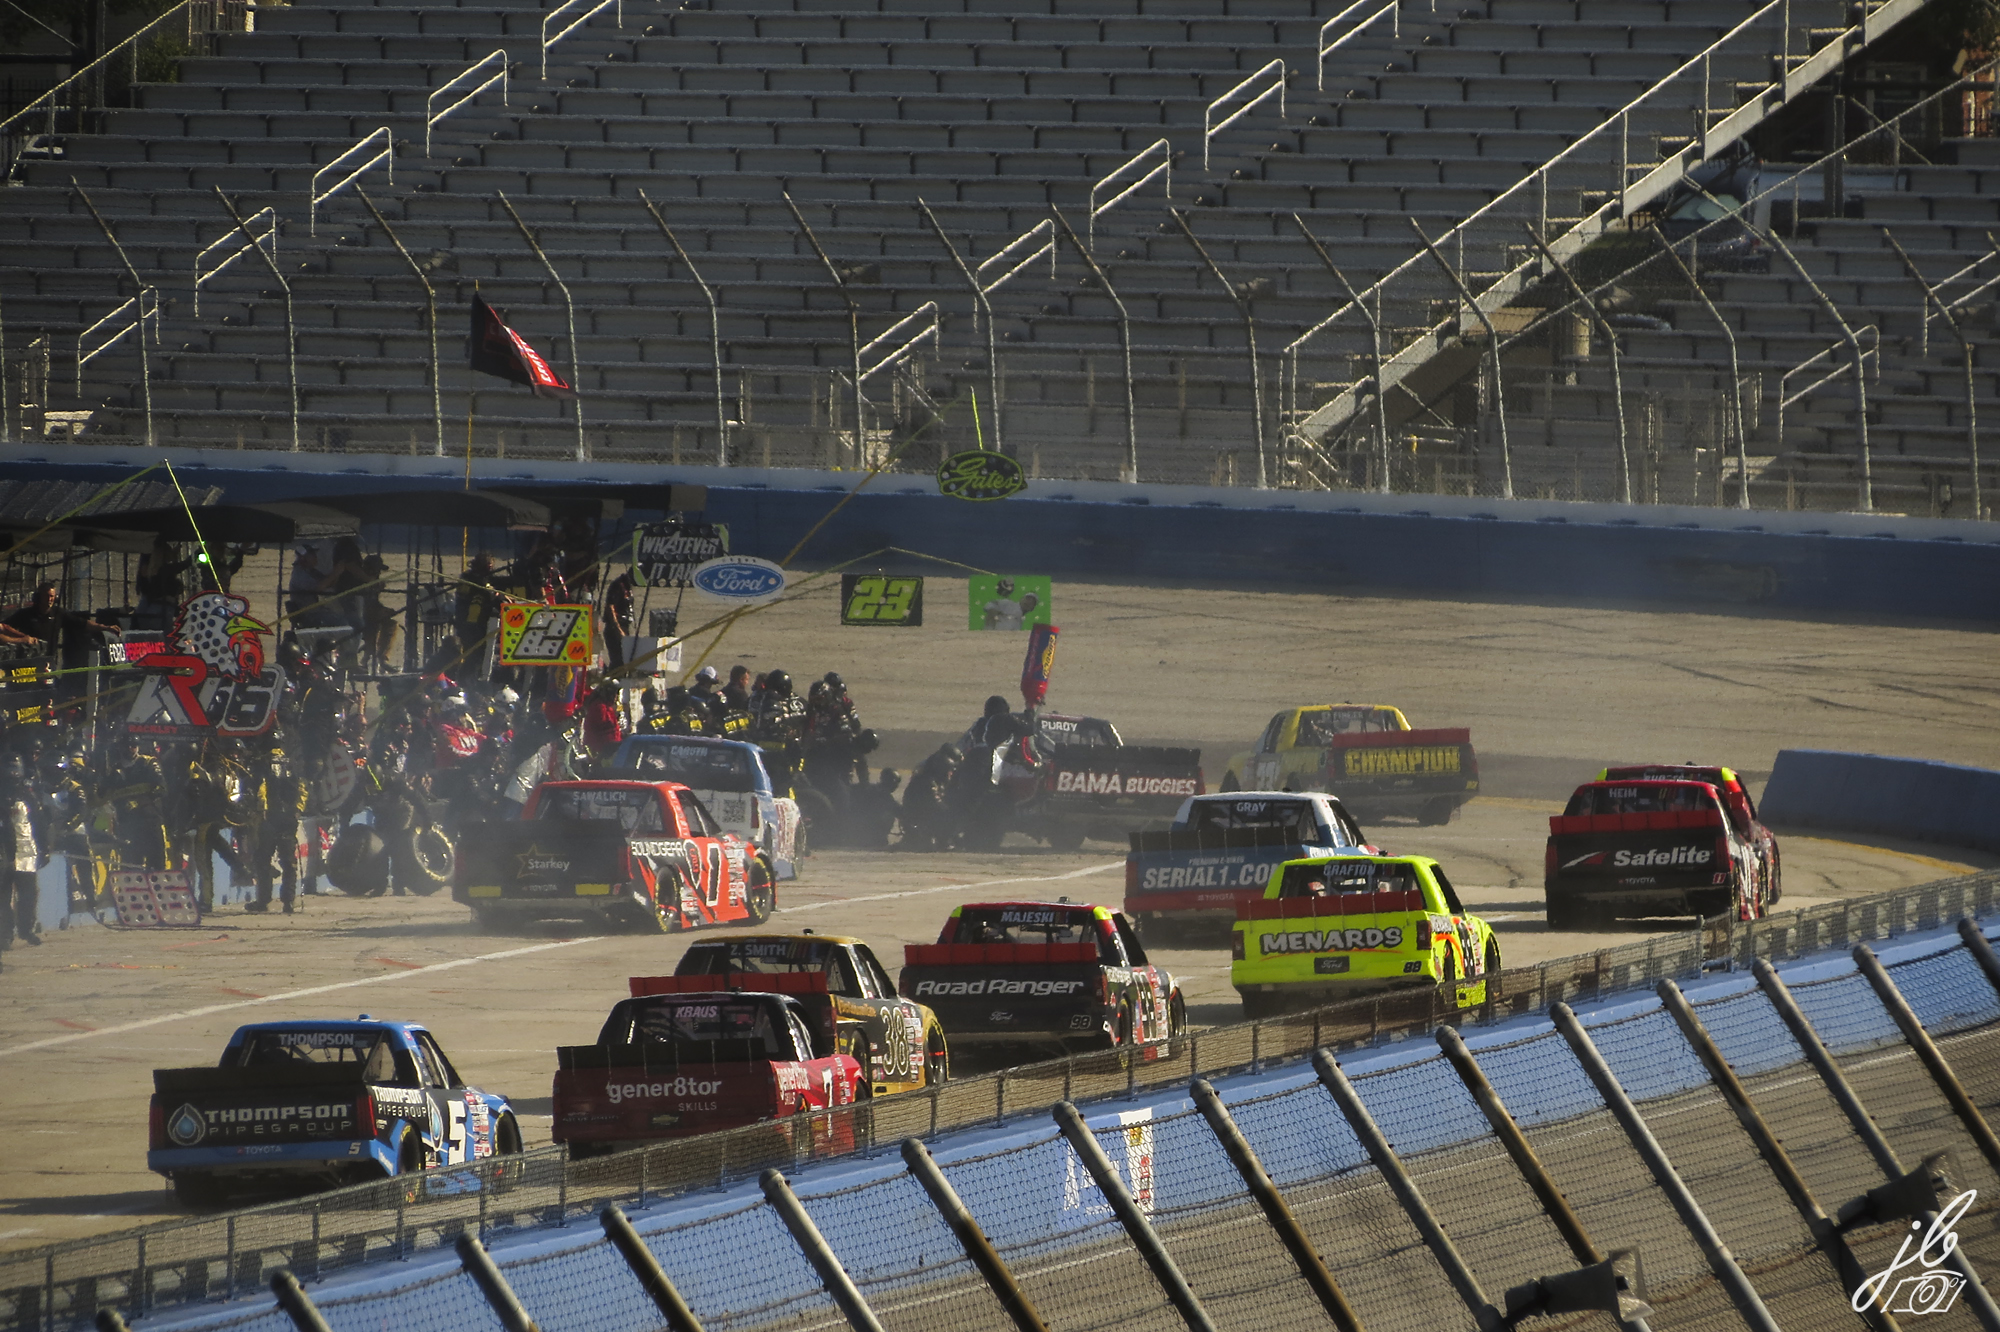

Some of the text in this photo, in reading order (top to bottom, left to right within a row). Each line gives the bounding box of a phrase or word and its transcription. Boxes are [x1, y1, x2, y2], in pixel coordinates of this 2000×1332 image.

[940, 457, 1019, 495] Gates
[642, 531, 720, 555] WHATEVER
[650, 563, 698, 579] IT TAK
[713, 568, 765, 591] Ford
[847, 580, 918, 620] 23
[512, 609, 580, 660] 2
[1041, 720, 1078, 732] PURDY
[1345, 747, 1461, 775] CHAMPION
[1057, 771, 1197, 796] BAMA BUGGIES
[573, 790, 628, 801] SAWALICH
[1609, 787, 1638, 798] HEIM
[1236, 802, 1267, 813] GRAY
[631, 841, 686, 857] SOUNDGEAR
[1613, 846, 1711, 867] Safelite
[528, 858, 570, 871] Starkey
[1625, 877, 1657, 885] TOYOTA
[1001, 911, 1054, 923] MAJESKI
[1261, 928, 1403, 953] MENARDS
[730, 944, 787, 956] Z. SMITH
[1403, 960, 1422, 973] 88
[915, 979, 1084, 997] Road Ranger
[675, 1005, 717, 1018] KRAUS
[989, 1010, 1013, 1021] Ford
[1069, 1014, 1092, 1030] 98
[279, 1033, 355, 1045] THOMPSON
[880, 1005, 909, 1076] 38
[371, 1085, 424, 1104] THOMPSON
[607, 1076, 722, 1103] gener8tor
[204, 1104, 348, 1124] THOMPSON
[377, 1103, 428, 1118] PIPEGROUP
[678, 1102, 717, 1112] SKILLS
[208, 1120, 352, 1136] PIPEGROUP
[447, 1099, 467, 1167] 5
[245, 1145, 283, 1155] TOYOTA
[348, 1142, 361, 1155] 5
